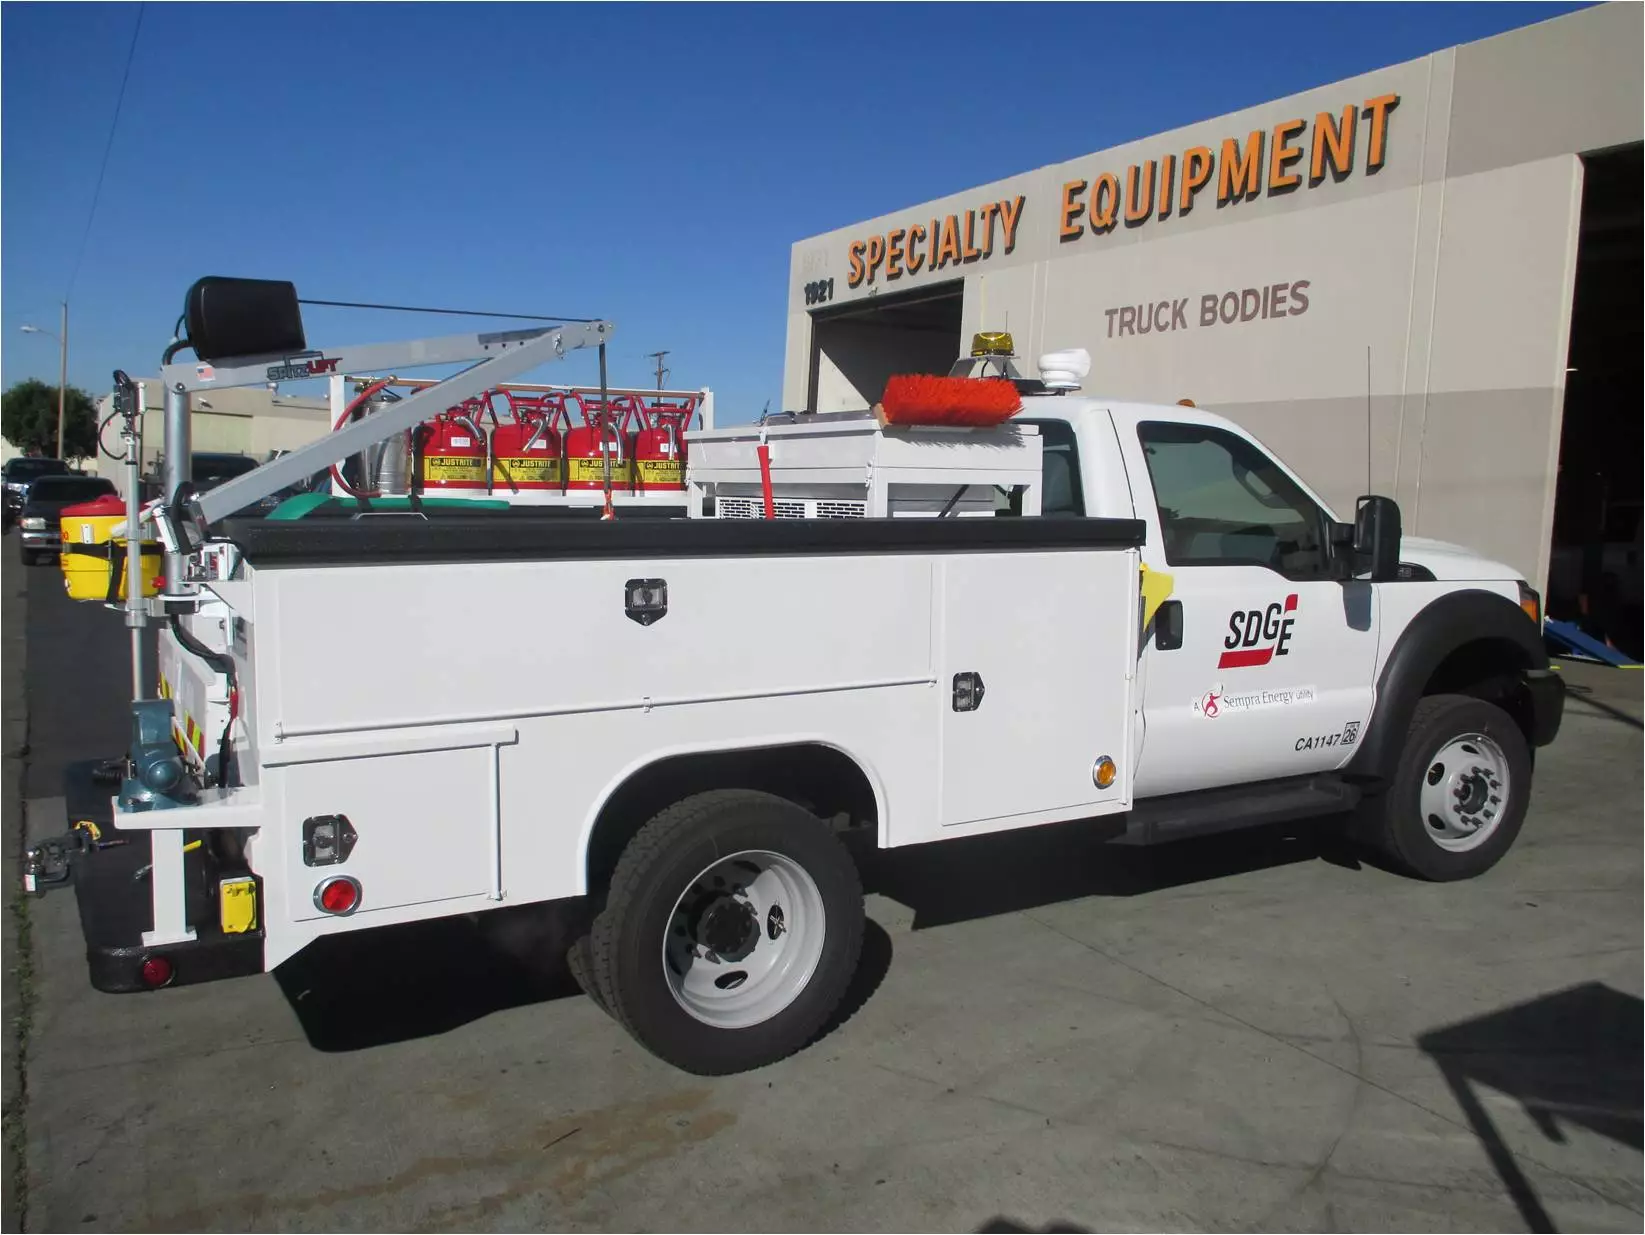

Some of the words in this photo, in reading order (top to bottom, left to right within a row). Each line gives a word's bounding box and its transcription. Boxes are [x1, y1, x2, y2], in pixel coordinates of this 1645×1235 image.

[848, 194, 1026, 289] SPECIALTY
[1060, 92, 1400, 243] EQUIPMENT
[1104, 298, 1189, 338] TRUCK
[1199, 279, 1310, 327] BODIES
[653, 462, 682, 470] JUSTRIT
[1224, 603, 1294, 656] SDGE
[1223, 694, 1261, 709] Sempra
[1262, 690, 1294, 705] Energy
[1294, 733, 1342, 752] CA1147
[1342, 727, 1357, 743] 26
